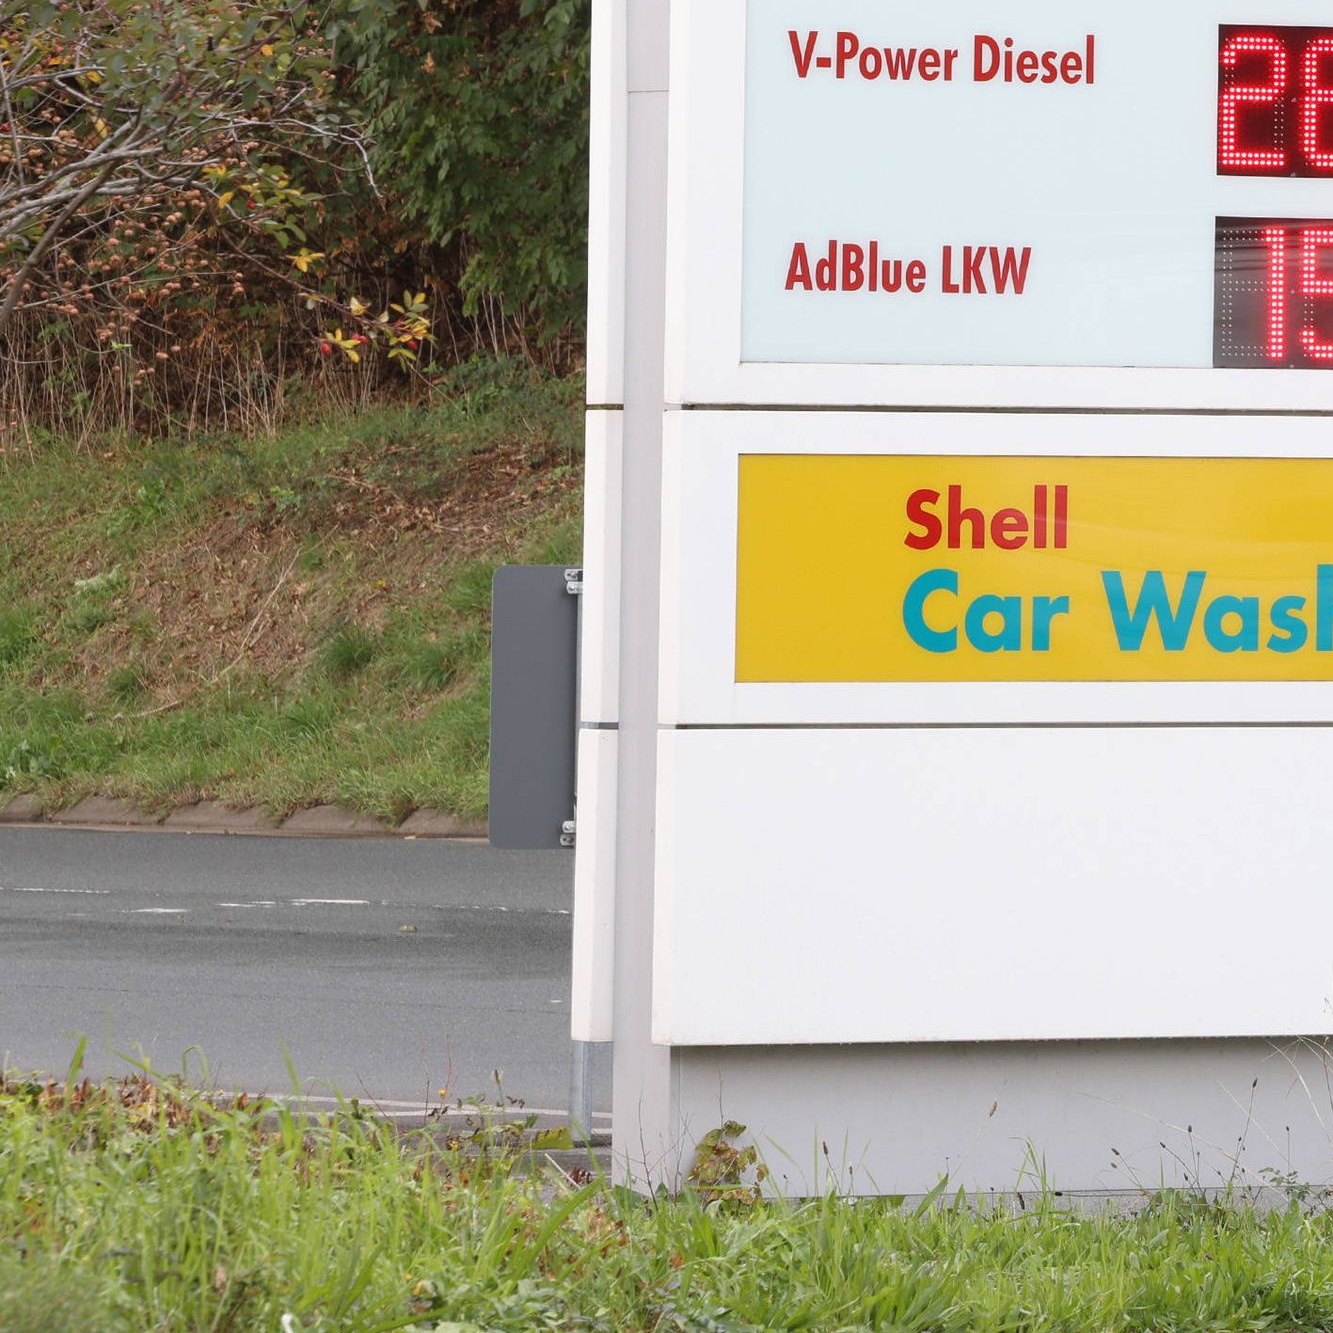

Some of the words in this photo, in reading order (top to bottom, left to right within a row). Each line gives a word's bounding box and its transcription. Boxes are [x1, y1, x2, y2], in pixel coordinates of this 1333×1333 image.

[790, 31, 958, 80] V-Power
[974, 35, 1094, 83] Diesel
[786, 241, 926, 292] AdBlue
[943, 246, 1030, 294] LKW
[905, 485, 1067, 550] Shell
[903, 569, 1069, 652] Car
